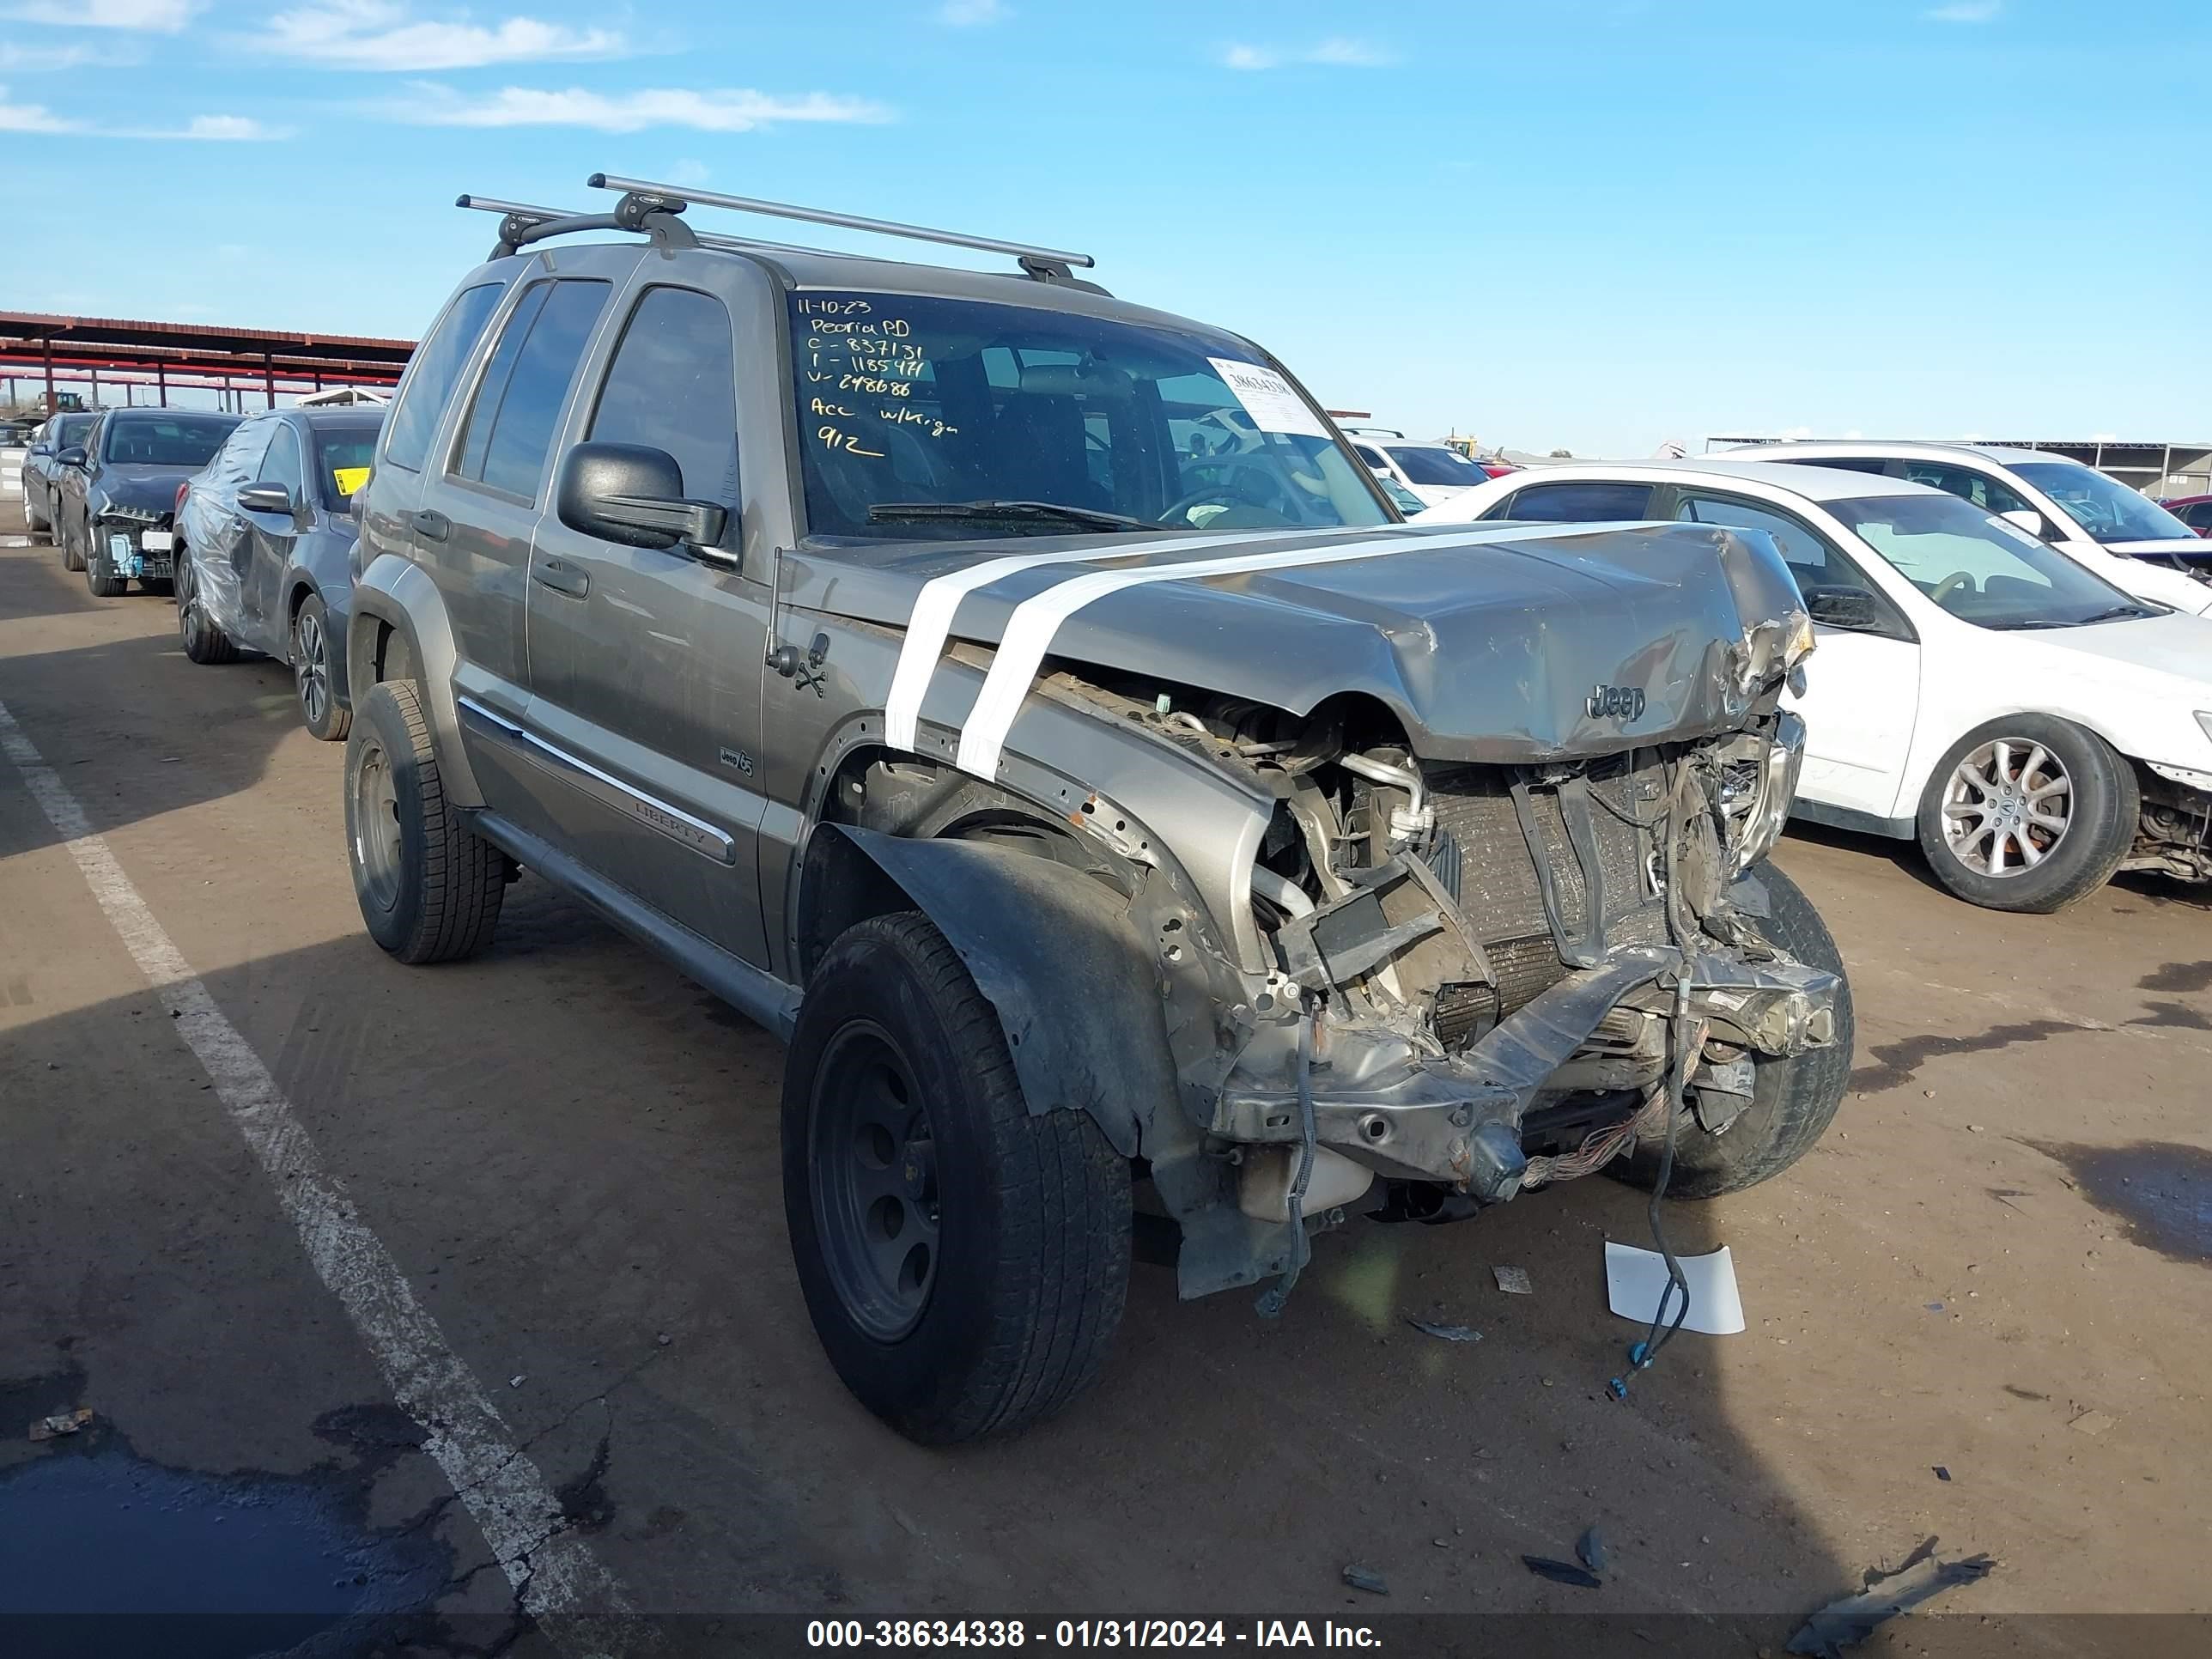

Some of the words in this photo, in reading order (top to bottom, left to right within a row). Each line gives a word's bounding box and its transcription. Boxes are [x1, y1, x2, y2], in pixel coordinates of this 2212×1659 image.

[798, 299, 872, 314] 11-10-23
[811, 319, 878, 336] Peoria
[882, 319, 910, 337] PD
[846, 338, 922, 360] 837131
[838, 374, 911, 397] 248686
[1586, 684, 1646, 722] Jeep
[721, 749, 738, 766] Jeep
[635, 803, 704, 843] LIBERTY
